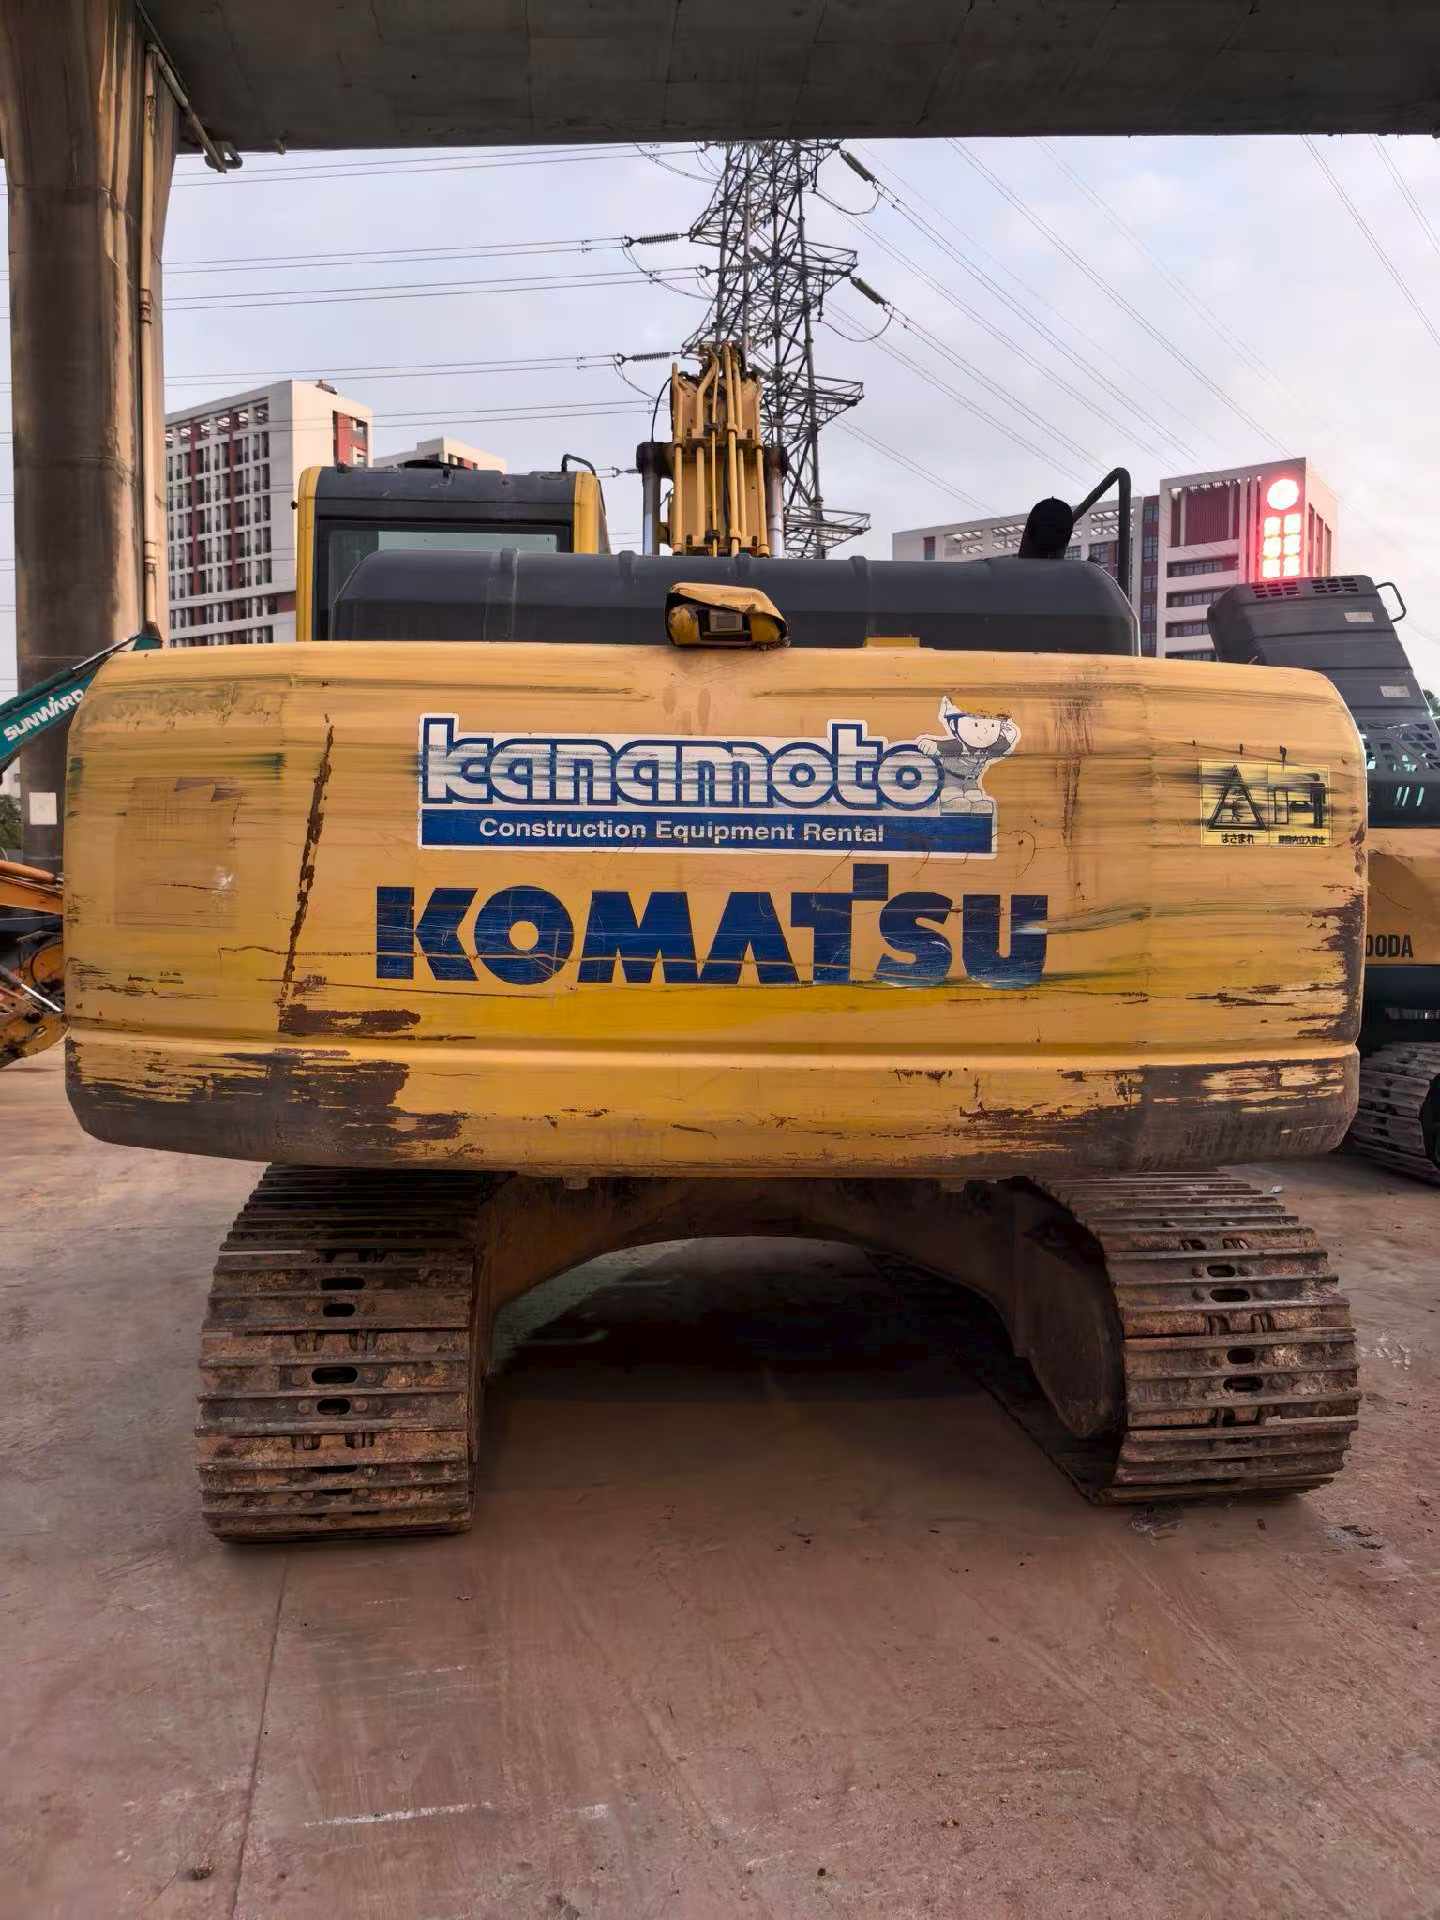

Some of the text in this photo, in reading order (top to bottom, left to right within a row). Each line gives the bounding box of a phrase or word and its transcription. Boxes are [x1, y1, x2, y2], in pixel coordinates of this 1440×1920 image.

[421, 717, 946, 810] kanamoto
[479, 817, 884, 844] Construction Equipment Rental
[376, 863, 1049, 989] KOMATSU
